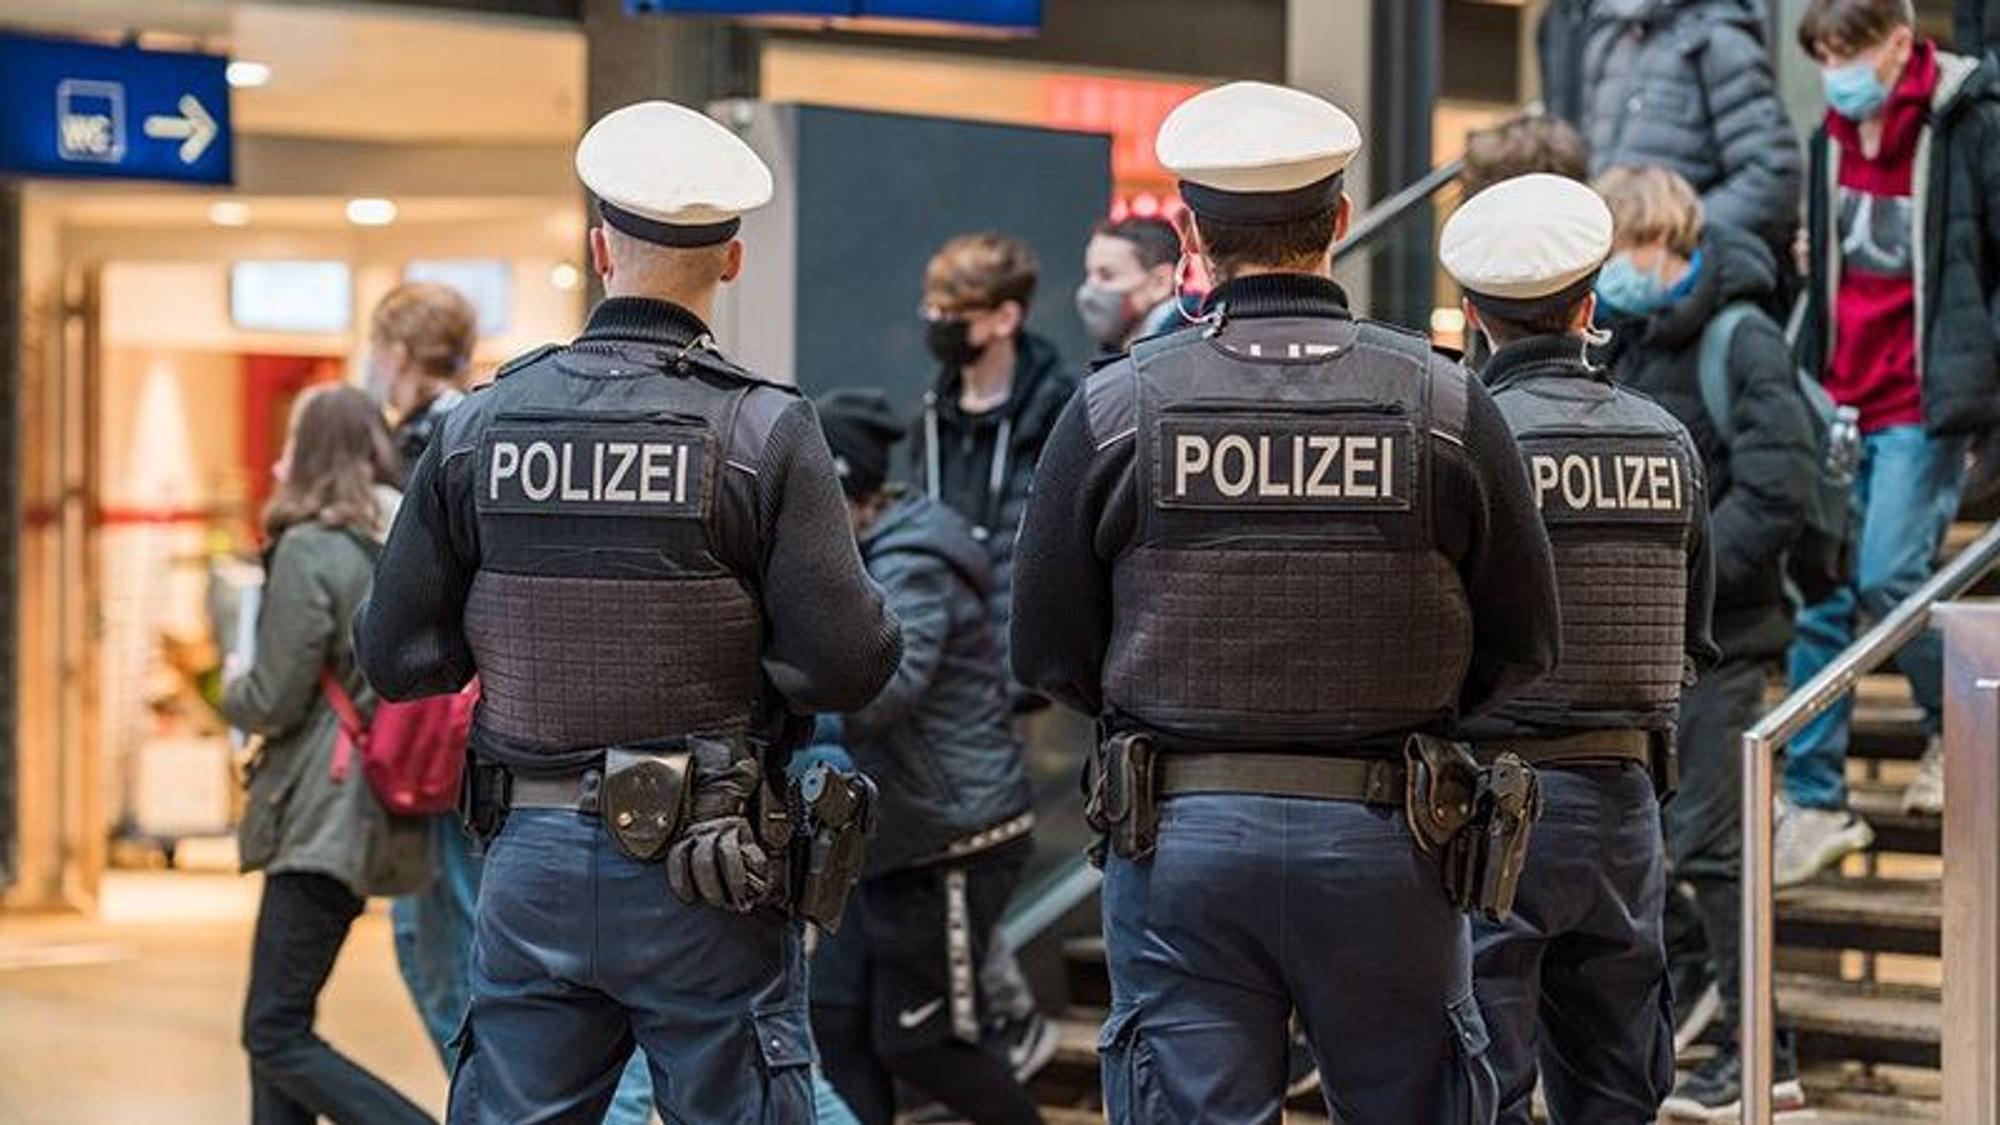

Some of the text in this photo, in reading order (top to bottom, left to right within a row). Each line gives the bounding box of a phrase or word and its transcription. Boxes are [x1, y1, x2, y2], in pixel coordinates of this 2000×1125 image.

[490, 441, 688, 503] POLIZEI
[1176, 434, 1392, 497] POLIZEI
[1532, 454, 1682, 509] POLIZEI
